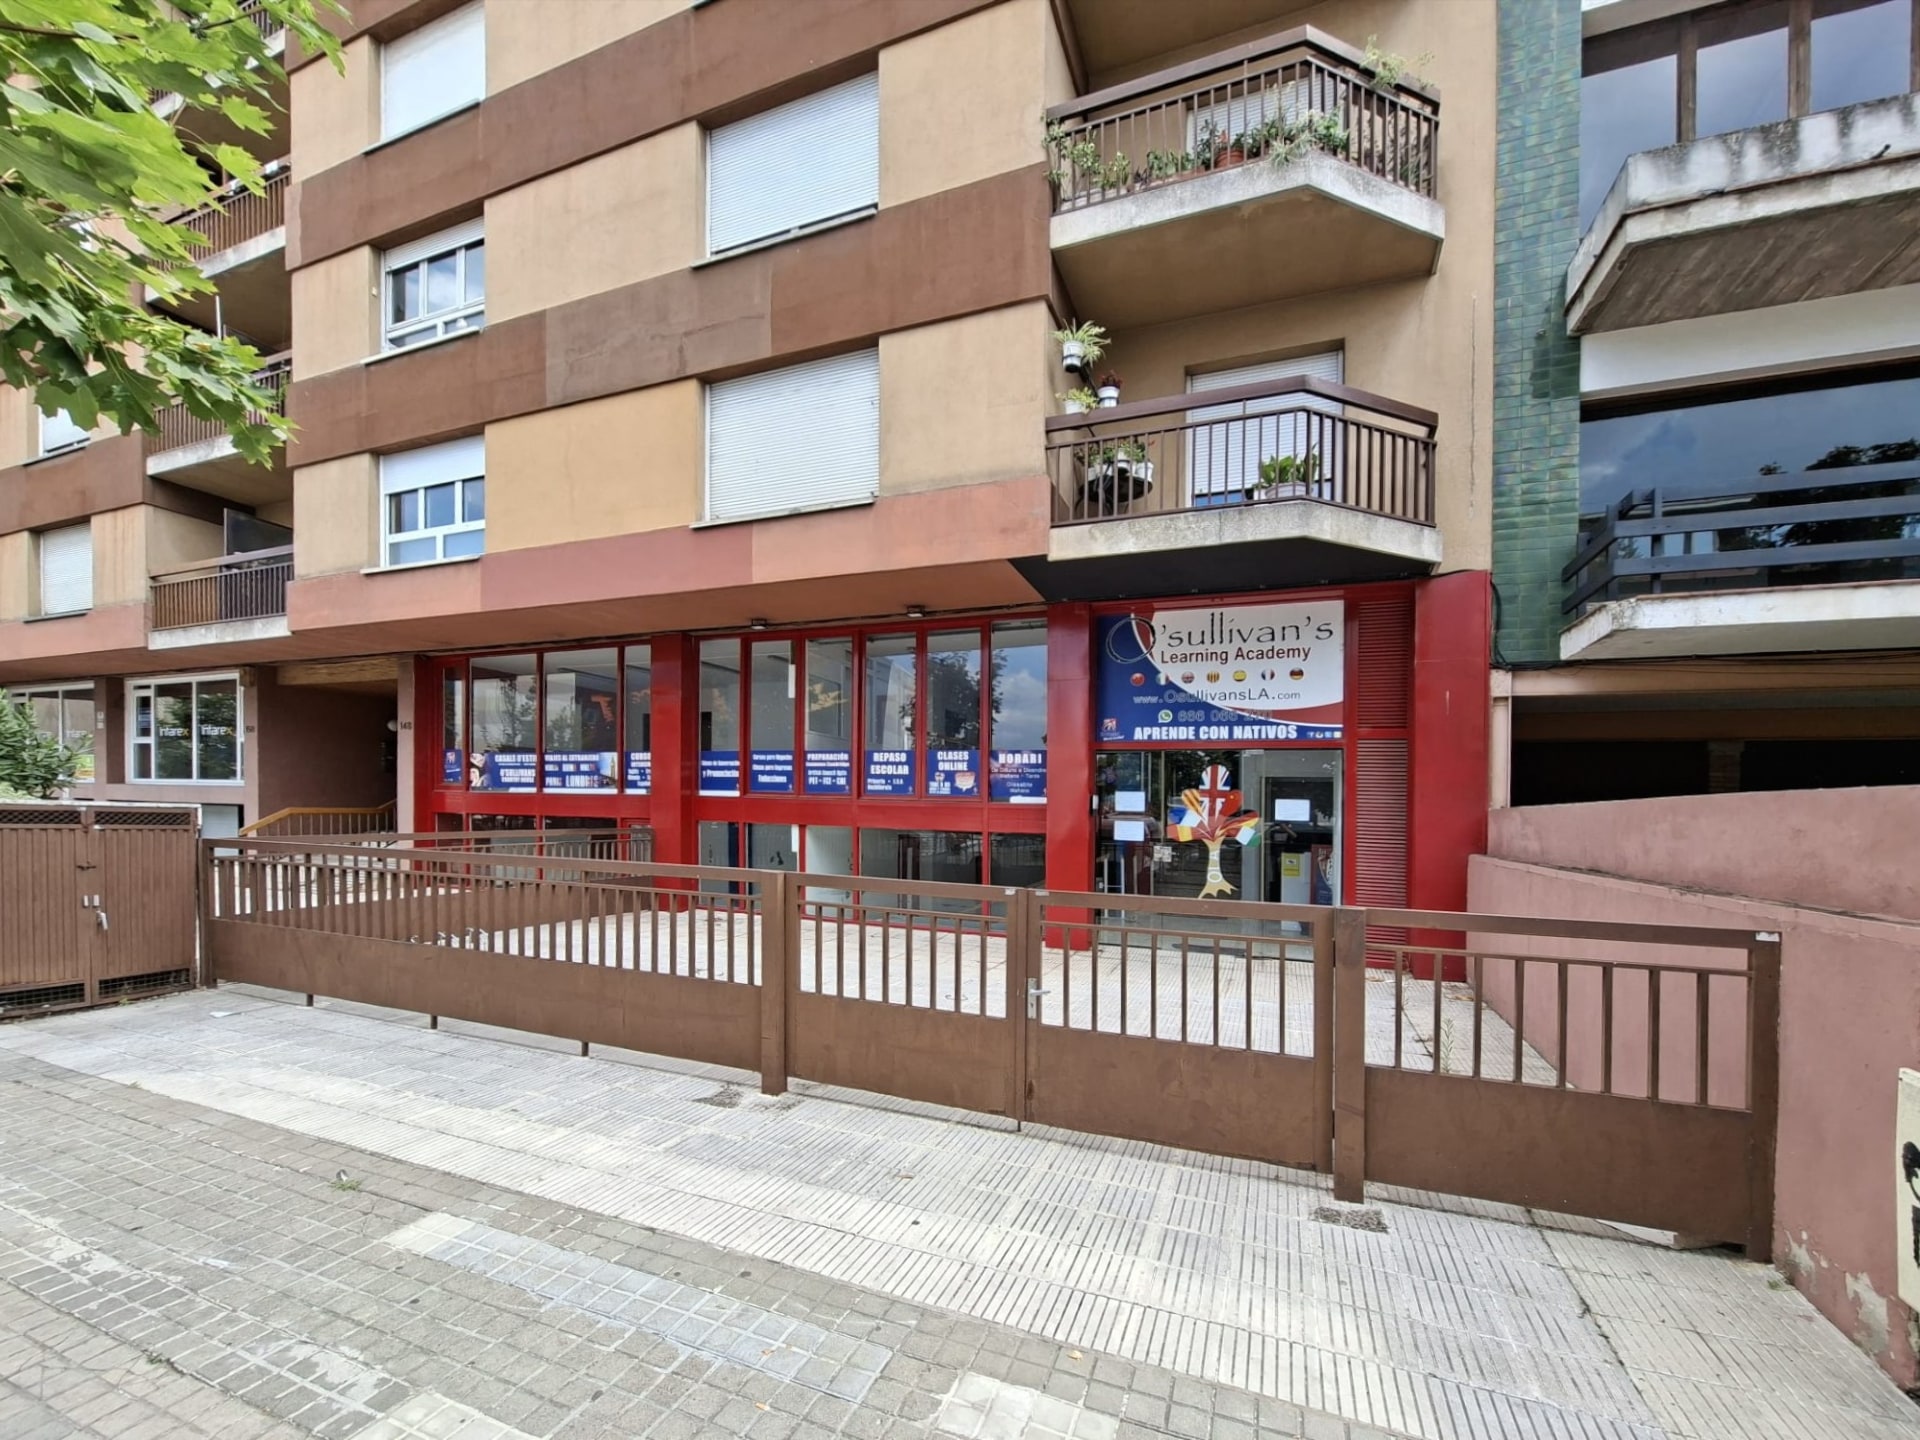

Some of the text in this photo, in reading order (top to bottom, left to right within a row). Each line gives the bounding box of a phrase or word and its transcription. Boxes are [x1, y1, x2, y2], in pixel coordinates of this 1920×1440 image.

[1161, 645, 1311, 664] Learning Academy
[1134, 726, 1196, 741] APRENDE
[1200, 726, 1229, 740] CON
[1233, 725, 1298, 740] NATIVOS
[873, 752, 907, 763] REPASO
[937, 751, 969, 761] CLASES
[870, 765, 909, 775] ESCOLAR
[938, 761, 968, 771] ONLINE
